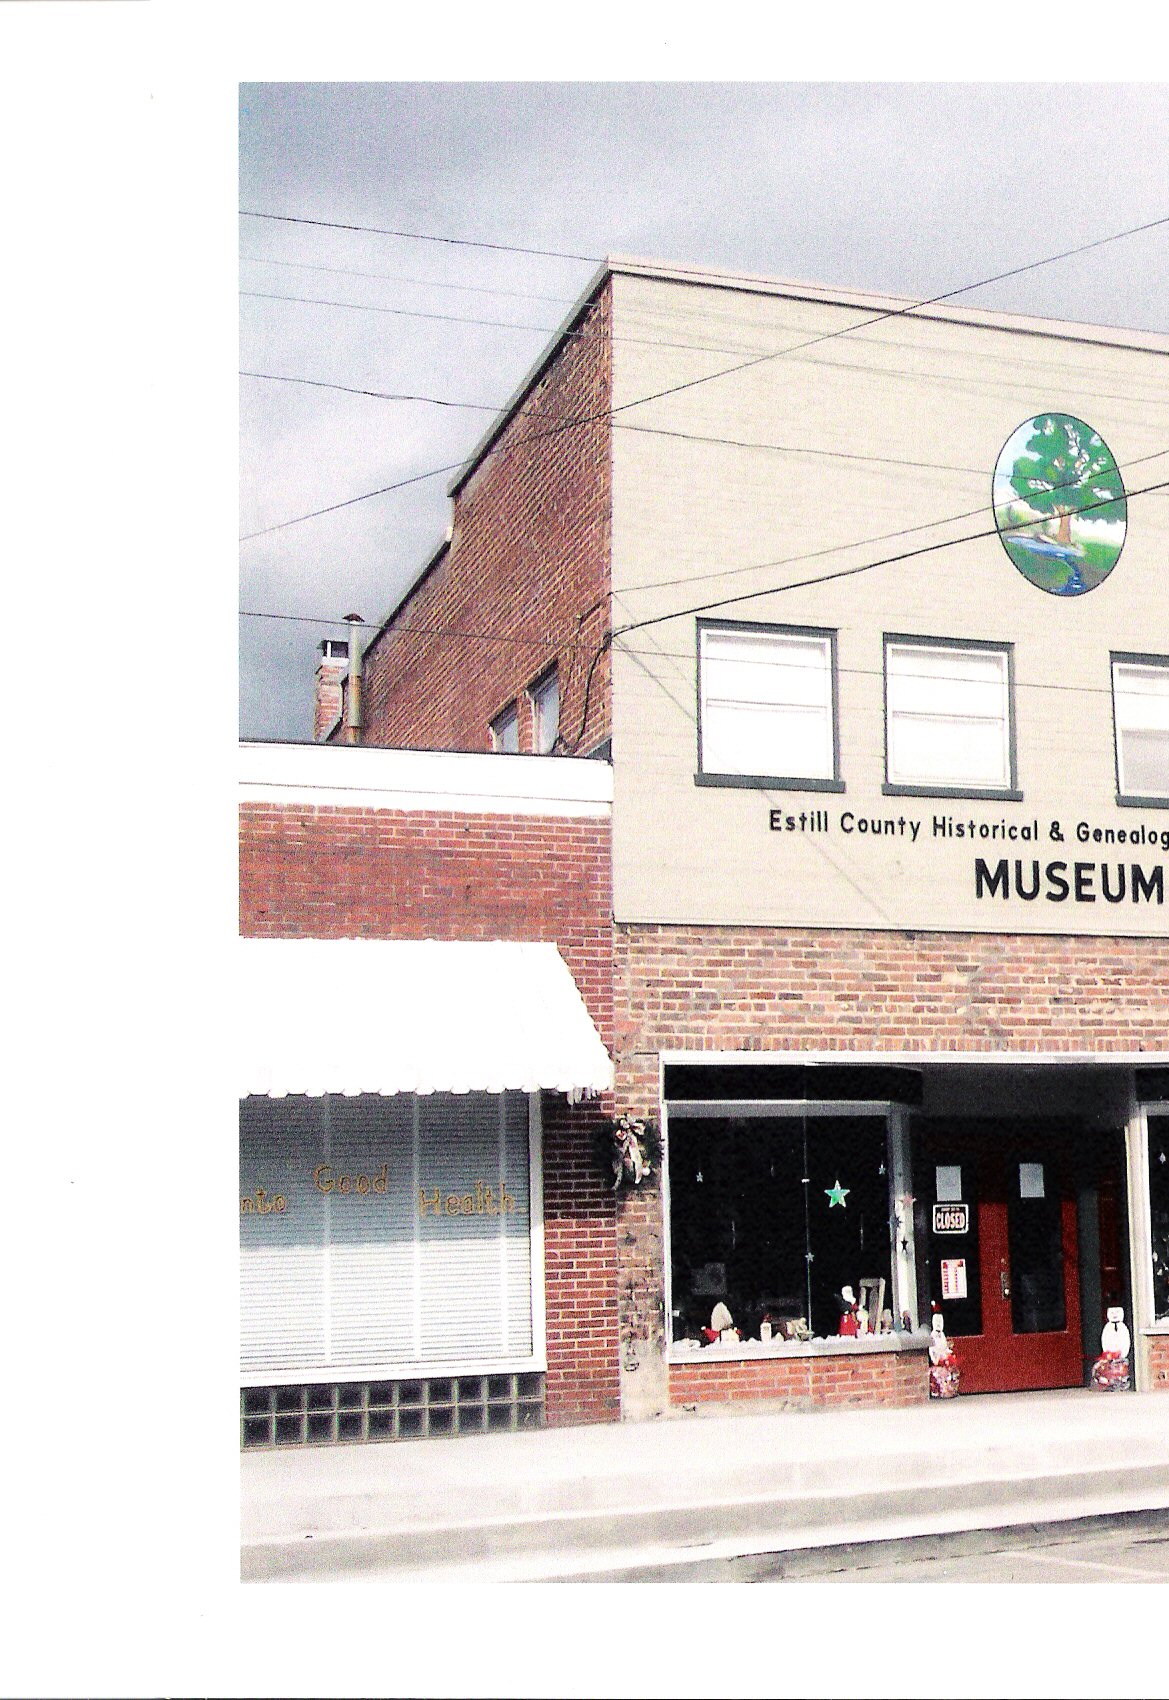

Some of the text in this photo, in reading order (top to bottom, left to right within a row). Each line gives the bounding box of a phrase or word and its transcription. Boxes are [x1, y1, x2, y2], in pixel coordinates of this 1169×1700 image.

[769, 809, 829, 833] Estill
[840, 812, 921, 843] County
[932, 815, 1039, 841] Historical
[1049, 820, 1066, 843] &
[974, 858, 1165, 905] MUSEUM
[312, 1163, 389, 1194] Good
[936, 1212, 966, 1230] CLOSED
